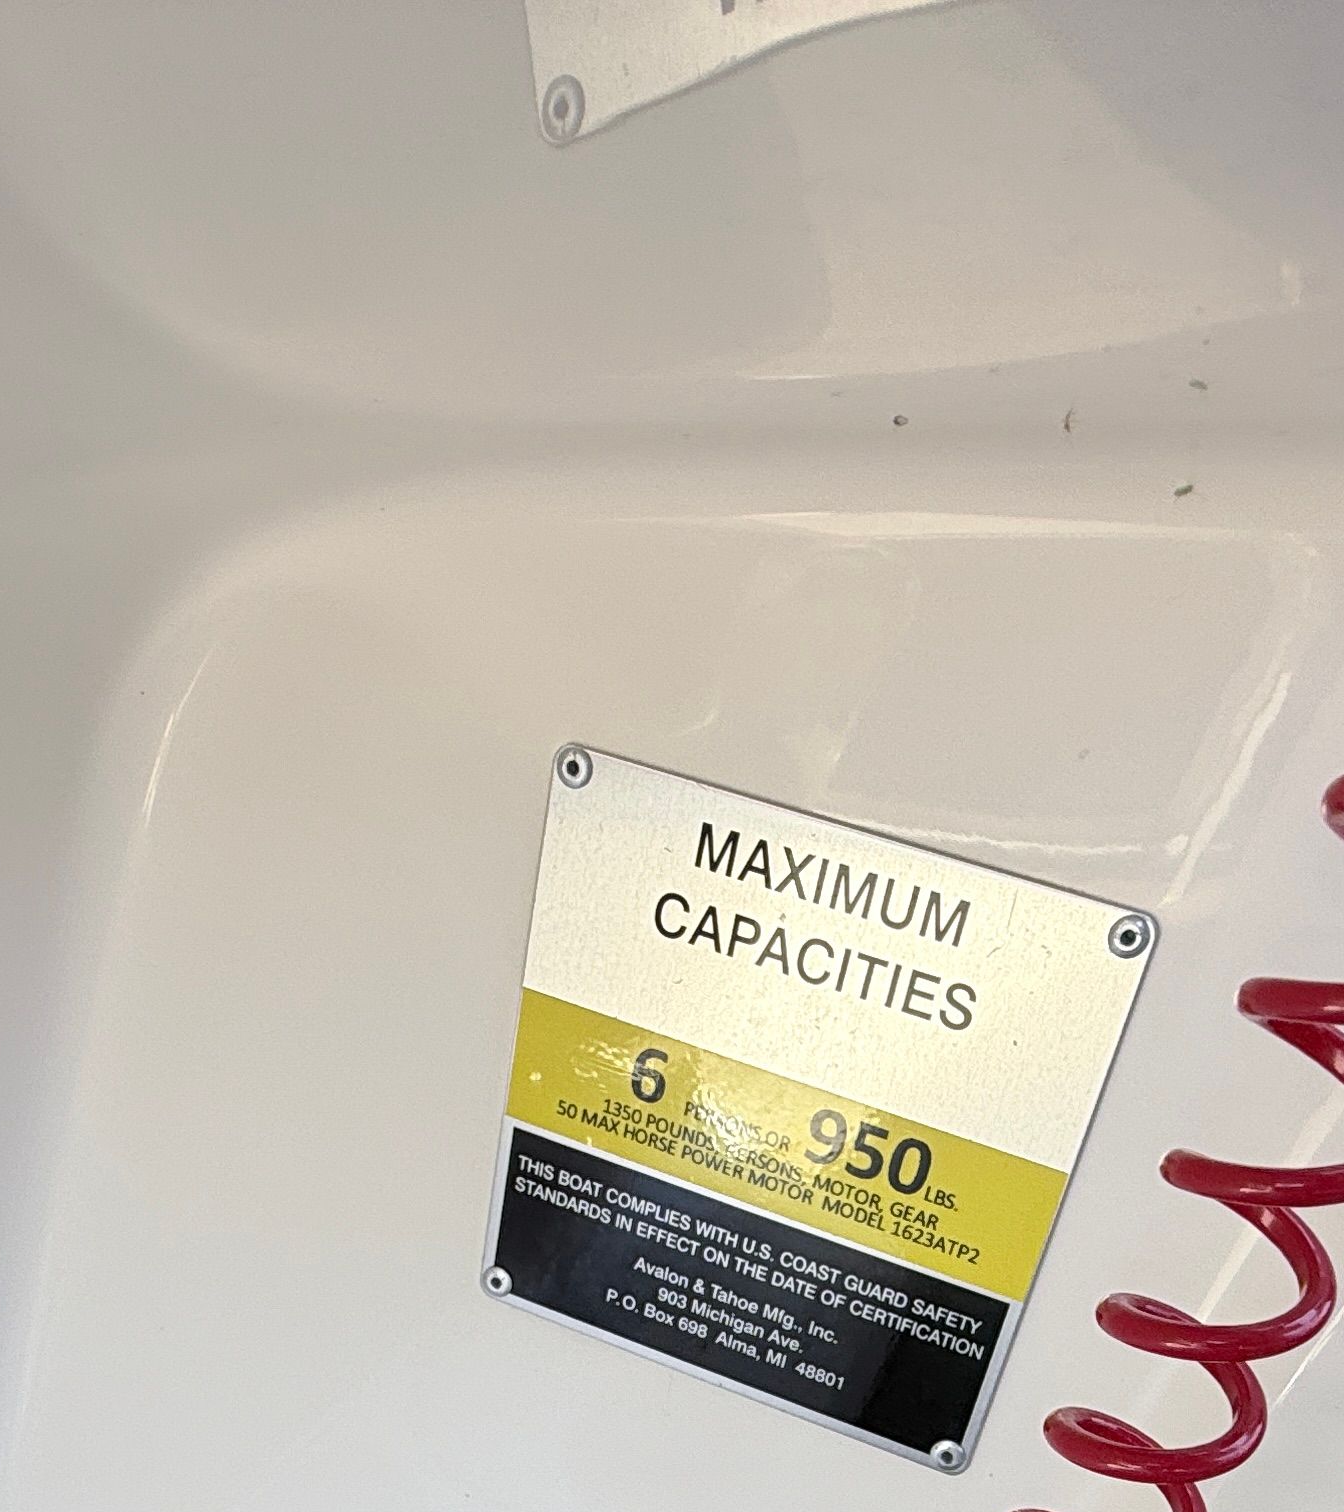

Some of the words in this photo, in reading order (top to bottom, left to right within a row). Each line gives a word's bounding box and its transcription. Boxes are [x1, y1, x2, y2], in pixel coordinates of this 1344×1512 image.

[694, 822, 971, 947] MAXIMUM
[655, 892, 977, 1031] CAPACITIES
[557, 1100, 577, 1119] 50
[582, 1108, 619, 1135] MAX
[624, 1123, 677, 1156] HORSE
[682, 1145, 743, 1179] POWER
[748, 1170, 814, 1205] MOTOR
[822, 1195, 885, 1231] MODEL
[891, 1221, 980, 1265] 1623ATP2
[603, 1099, 642, 1124] 1350
[812, 1174, 883, 1213] MOTOR,
[890, 1202, 939, 1230] GEAR
[631, 1048, 668, 1103] 6
[765, 1129, 791, 1152] OR
[805, 1109, 932, 1195] 950
[924, 1186, 958, 1212] LBS.
[515, 1176, 611, 1224] STANDARDS
[615, 1213, 633, 1232] IN
[636, 1221, 701, 1256] EFFECT
[703, 1247, 731, 1268] ON
[734, 1256, 768, 1282] THE
[771, 1271, 817, 1300] DATE
[820, 1290, 847, 1309] OF
[849, 1300, 985, 1360] CERTIFICATION
[518, 1155, 555, 1181] THIS
[558, 1170, 603, 1197] BOAT
[607, 1188, 691, 1230] COMPLIES
[695, 1219, 739, 1248] WITH
[742, 1237, 774, 1262] U.S.
[780, 1252, 842, 1284] COAST
[844, 1275, 907, 1309] GUARD
[912, 1299, 983, 1334] SAFETY
[633, 1257, 689, 1289] Avalon
[693, 1278, 705, 1295] &
[710, 1283, 759, 1314] Tahoe
[762, 1304, 803, 1333] Mfg.,
[808, 1320, 839, 1345] Inc.
[606, 1289, 638, 1314] P.O.
[643, 1303, 674, 1326] Box
[678, 1317, 708, 1339] 698
[715, 1331, 760, 1361] Alma,
[765, 1349, 787, 1368] MI
[794, 1362, 845, 1391] 48801
[657, 1287, 688, 1310] 903
[691, 1299, 764, 1338] Michigan
[767, 1327, 804, 1353] Ave.
